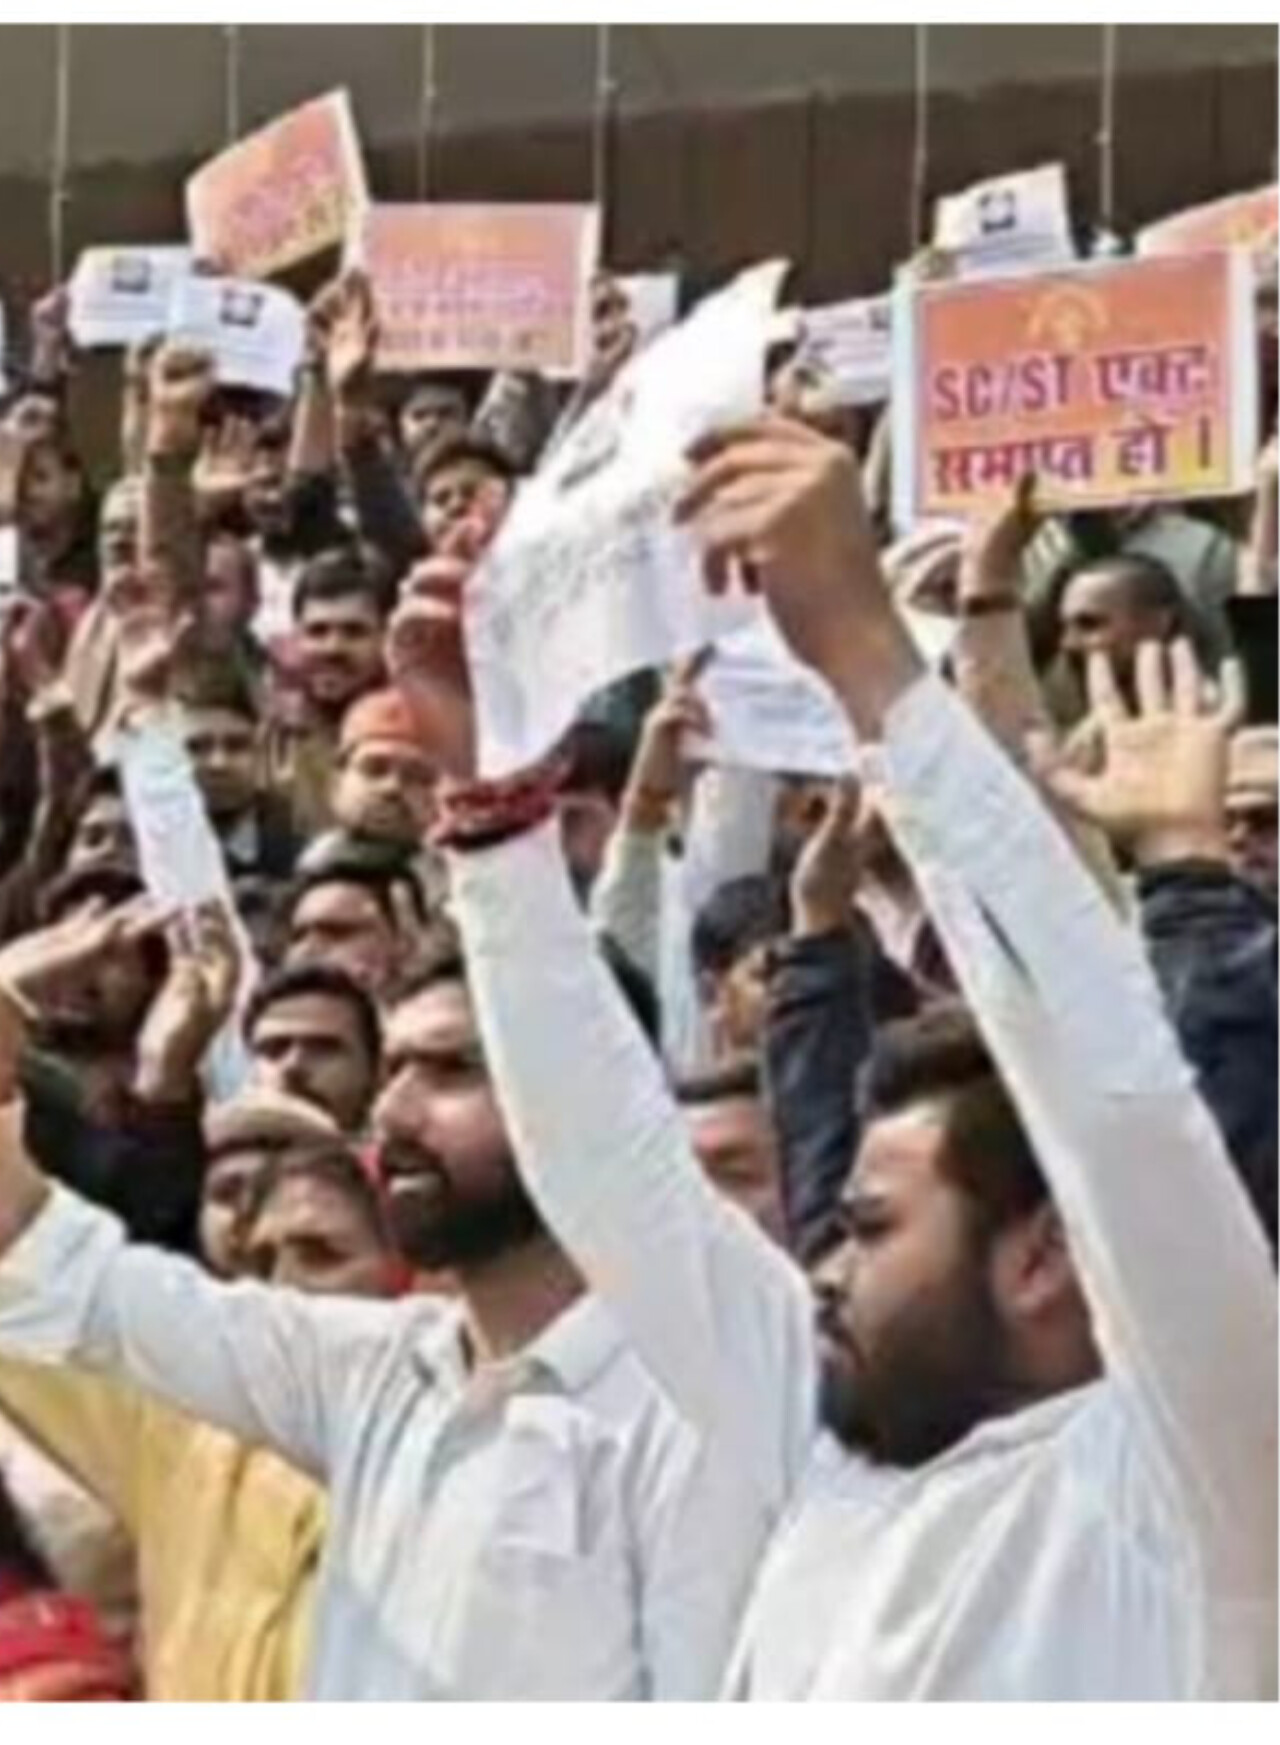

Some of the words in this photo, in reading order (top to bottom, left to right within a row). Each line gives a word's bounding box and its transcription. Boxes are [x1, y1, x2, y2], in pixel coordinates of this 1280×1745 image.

[934, 354, 1072, 421] SC/ST
[931, 435, 1095, 495] समाप्त
[1111, 413, 1172, 476] हो
